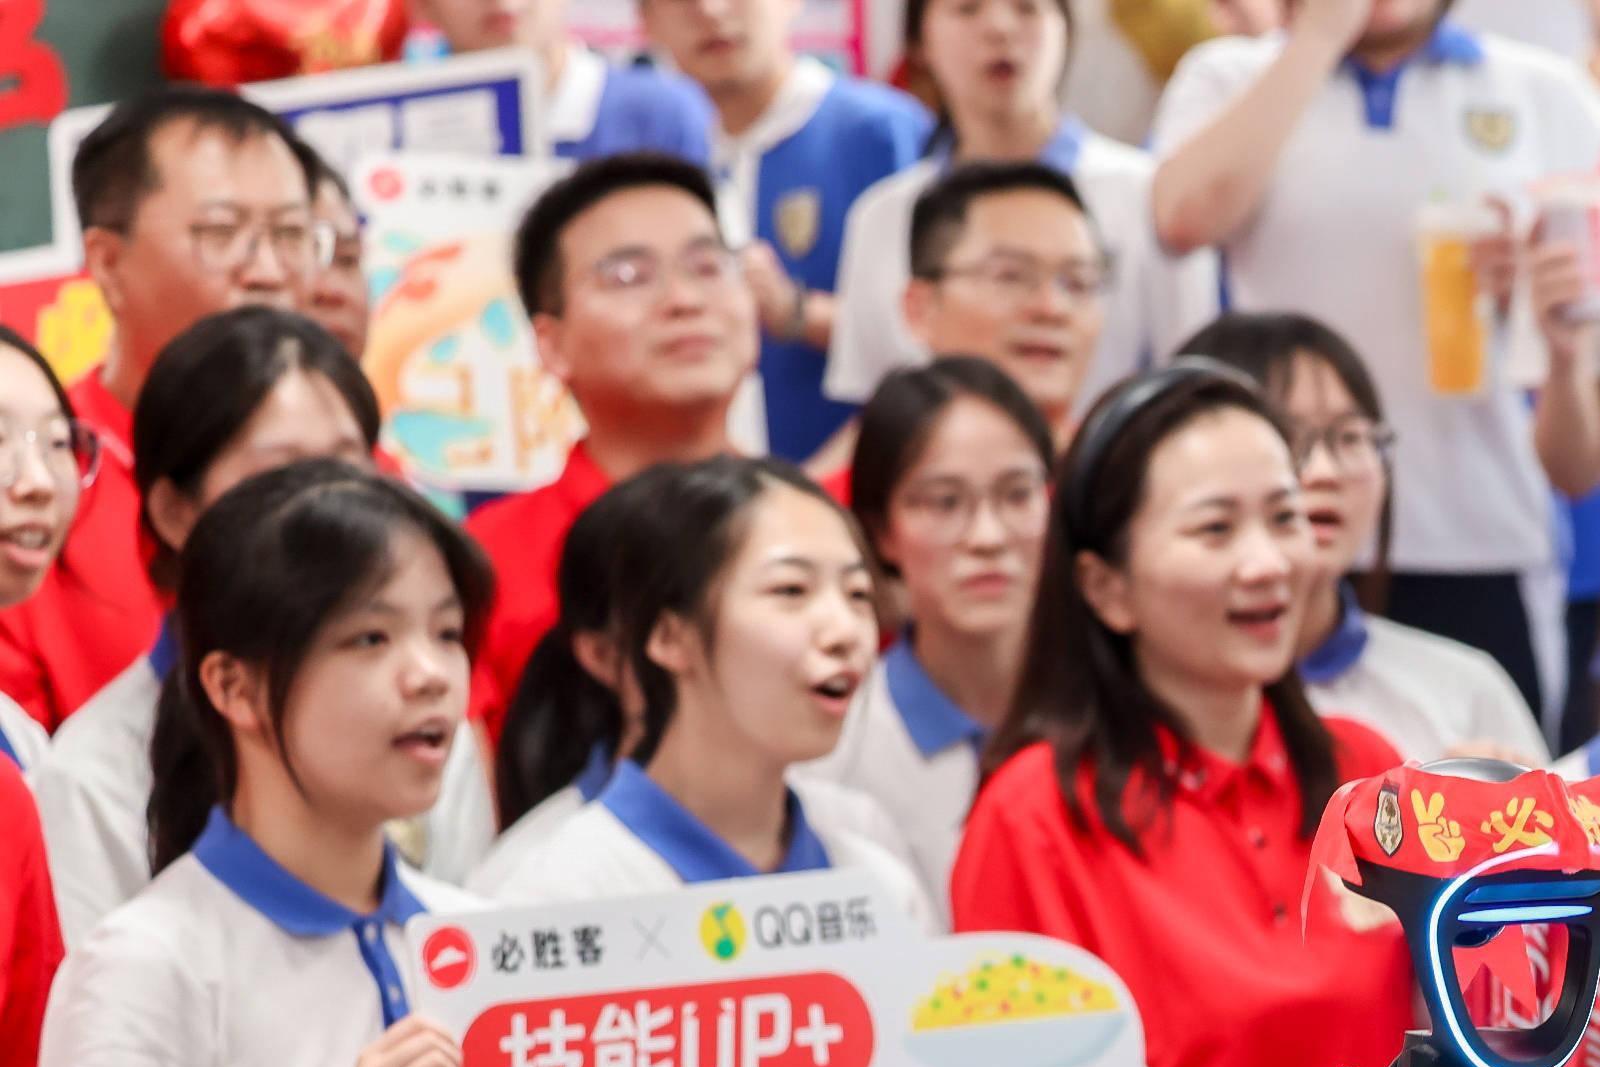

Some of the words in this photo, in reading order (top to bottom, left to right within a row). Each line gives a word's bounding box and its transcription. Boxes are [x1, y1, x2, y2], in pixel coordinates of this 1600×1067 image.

[754, 896, 877, 950] QQ音乐
[490, 926, 605, 974] 必胜客
